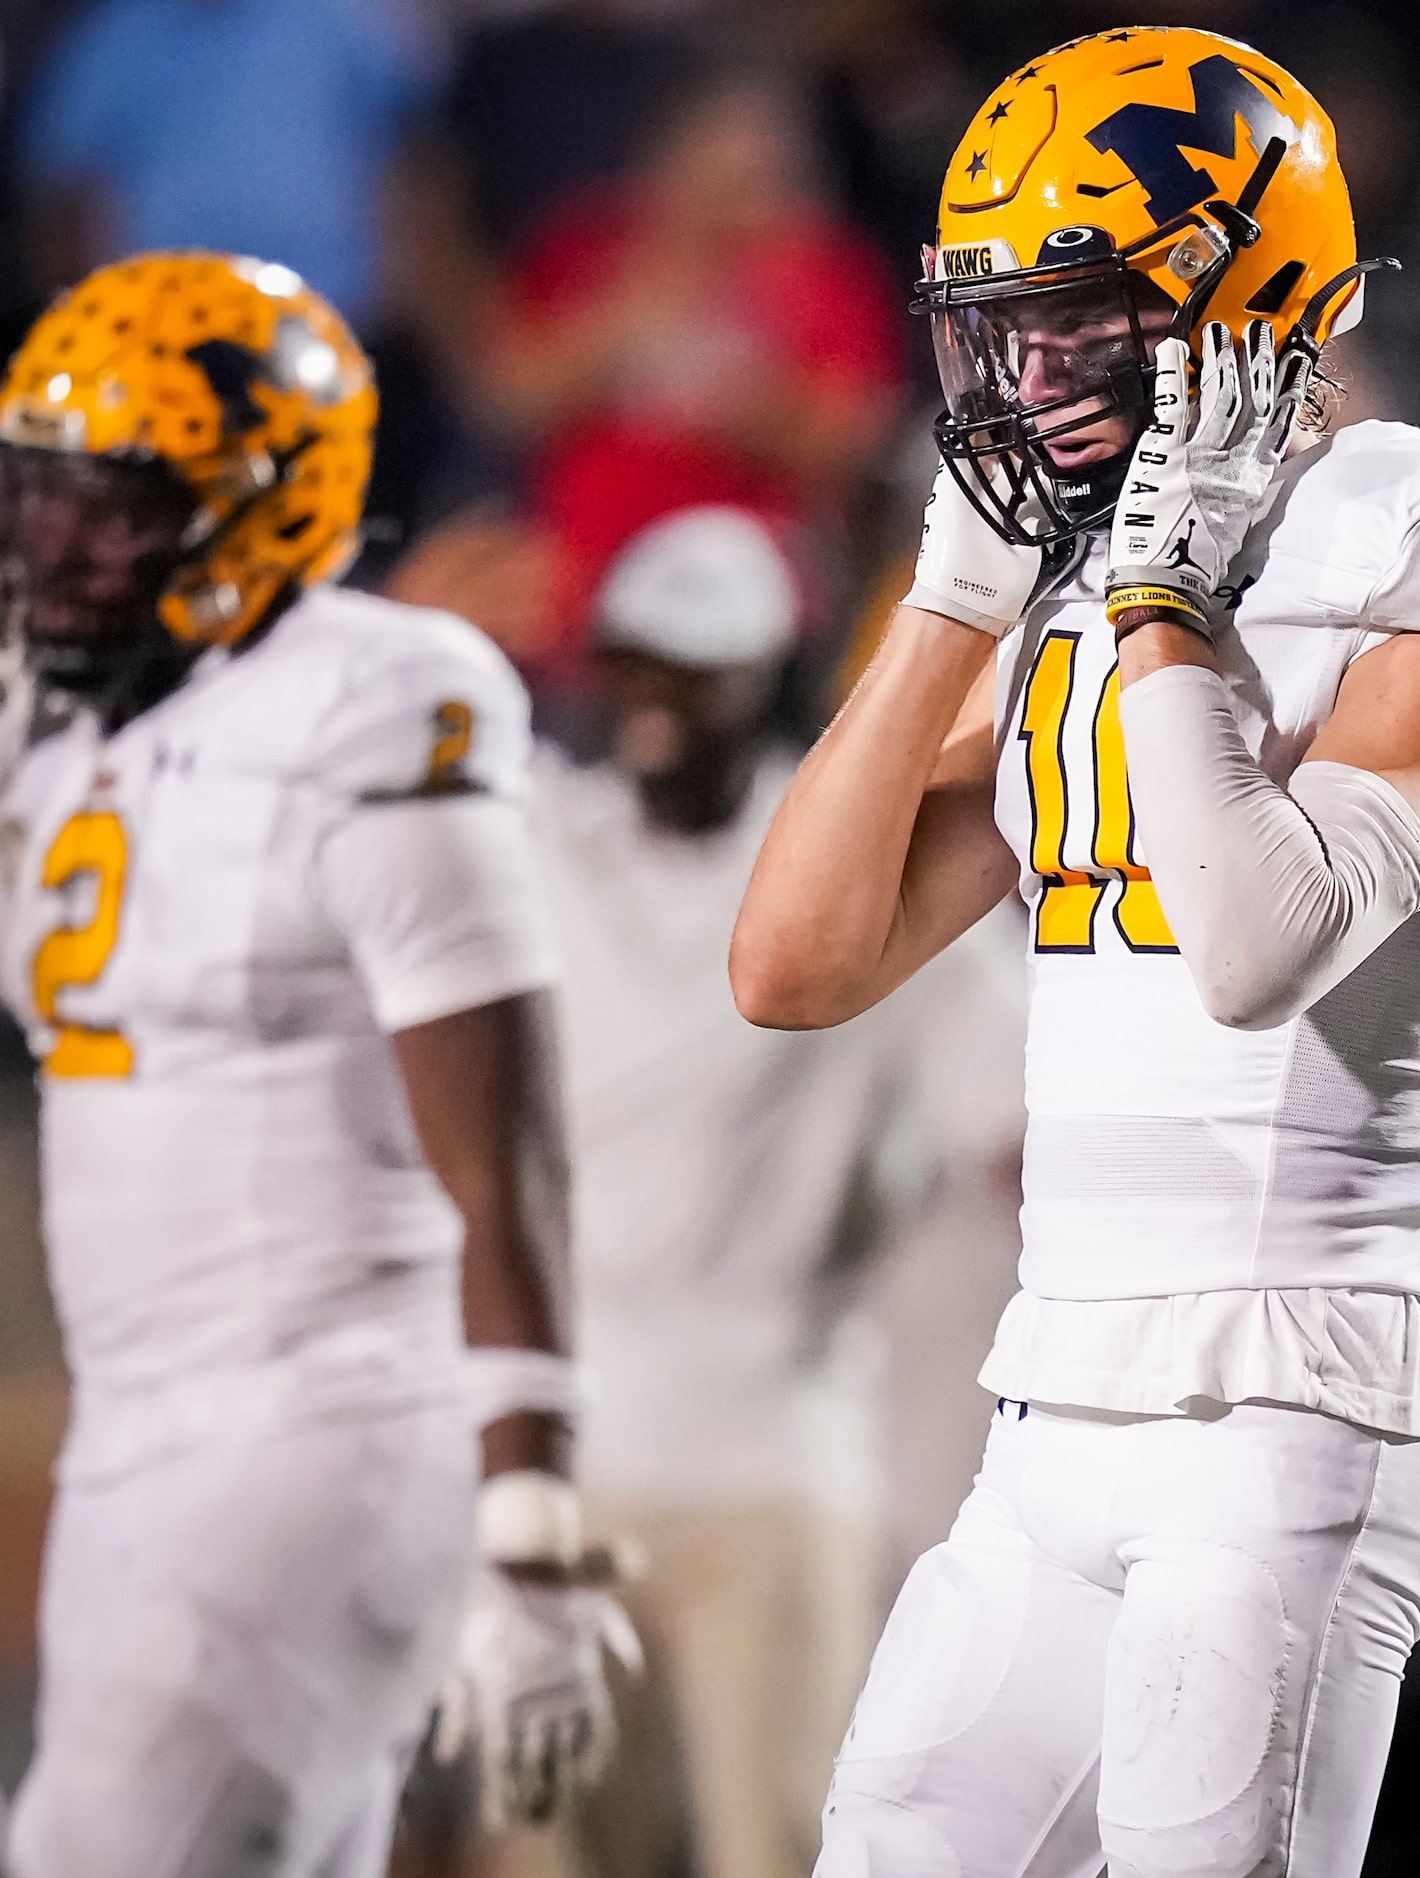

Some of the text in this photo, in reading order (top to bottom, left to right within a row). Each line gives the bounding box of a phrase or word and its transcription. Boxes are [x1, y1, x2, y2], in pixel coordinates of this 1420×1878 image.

[943, 247, 993, 278] WAWG
[954, 577, 998, 595] ENGINEERED
[954, 583, 996, 599] FOR FLIGHT
[1141, 592, 1171, 601] LIONS
[422, 700, 482, 795] 2
[30, 812, 135, 1080] 2
